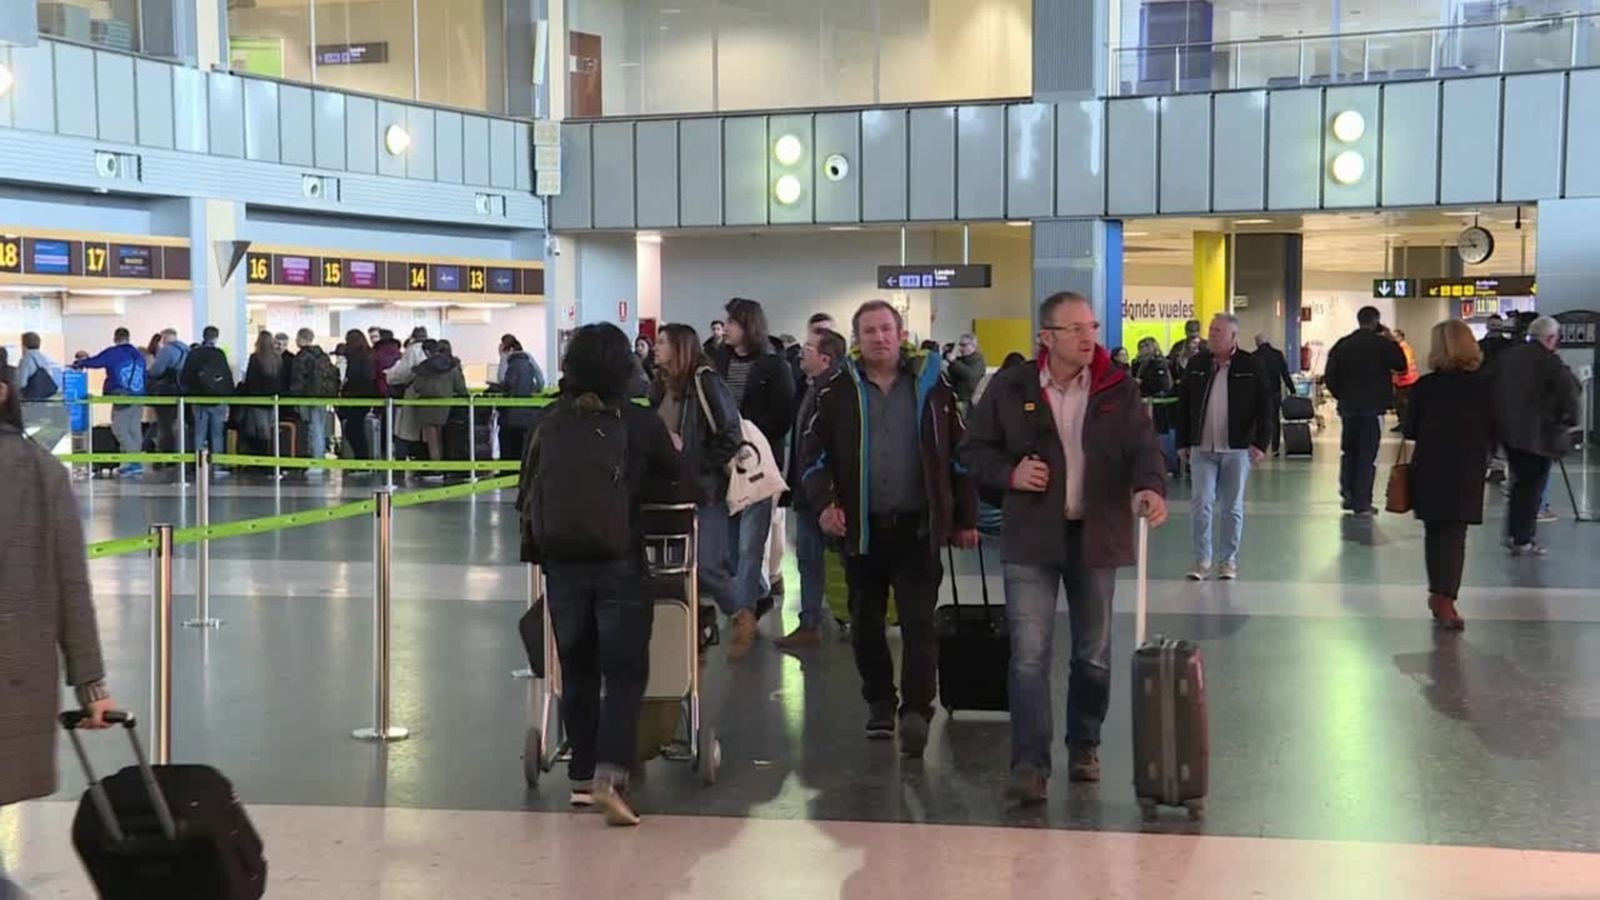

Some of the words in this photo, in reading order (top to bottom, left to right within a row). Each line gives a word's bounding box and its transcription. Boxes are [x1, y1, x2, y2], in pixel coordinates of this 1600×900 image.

[87, 247, 105, 272] 17
[250, 258, 268, 280] 16
[324, 262, 341, 283] 15
[411, 267, 426, 288] 14
[470, 269, 484, 290] 13
[1121, 298, 1156, 318] donde
[1158, 299, 1195, 318] vueles
